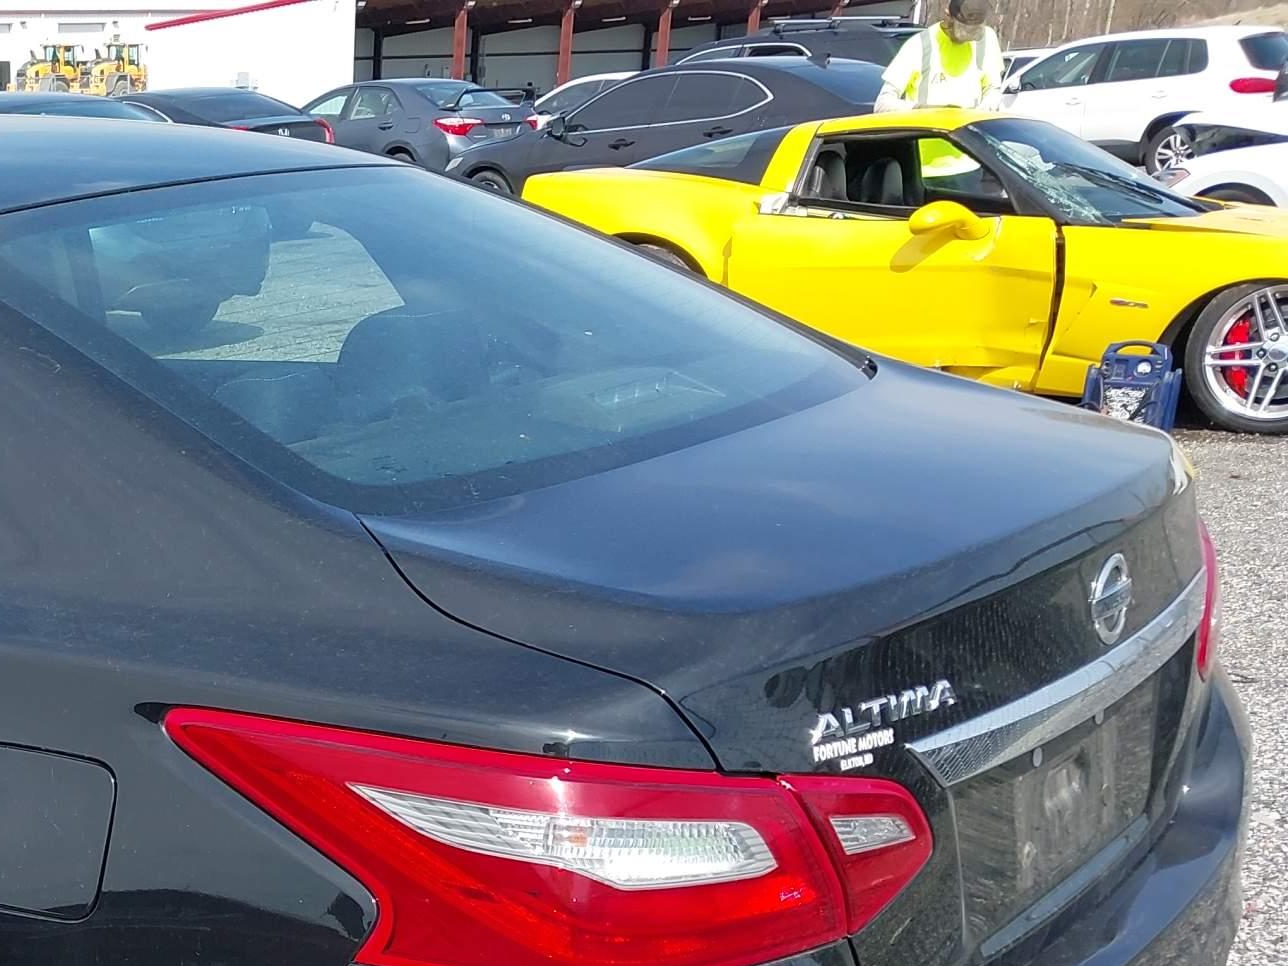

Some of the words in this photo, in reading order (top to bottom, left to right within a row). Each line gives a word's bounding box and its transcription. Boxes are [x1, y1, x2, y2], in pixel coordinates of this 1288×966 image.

[810, 679, 957, 744] ALTIMA
[814, 737, 858, 762] FORTUNE
[858, 727, 894, 751] MOTORS
